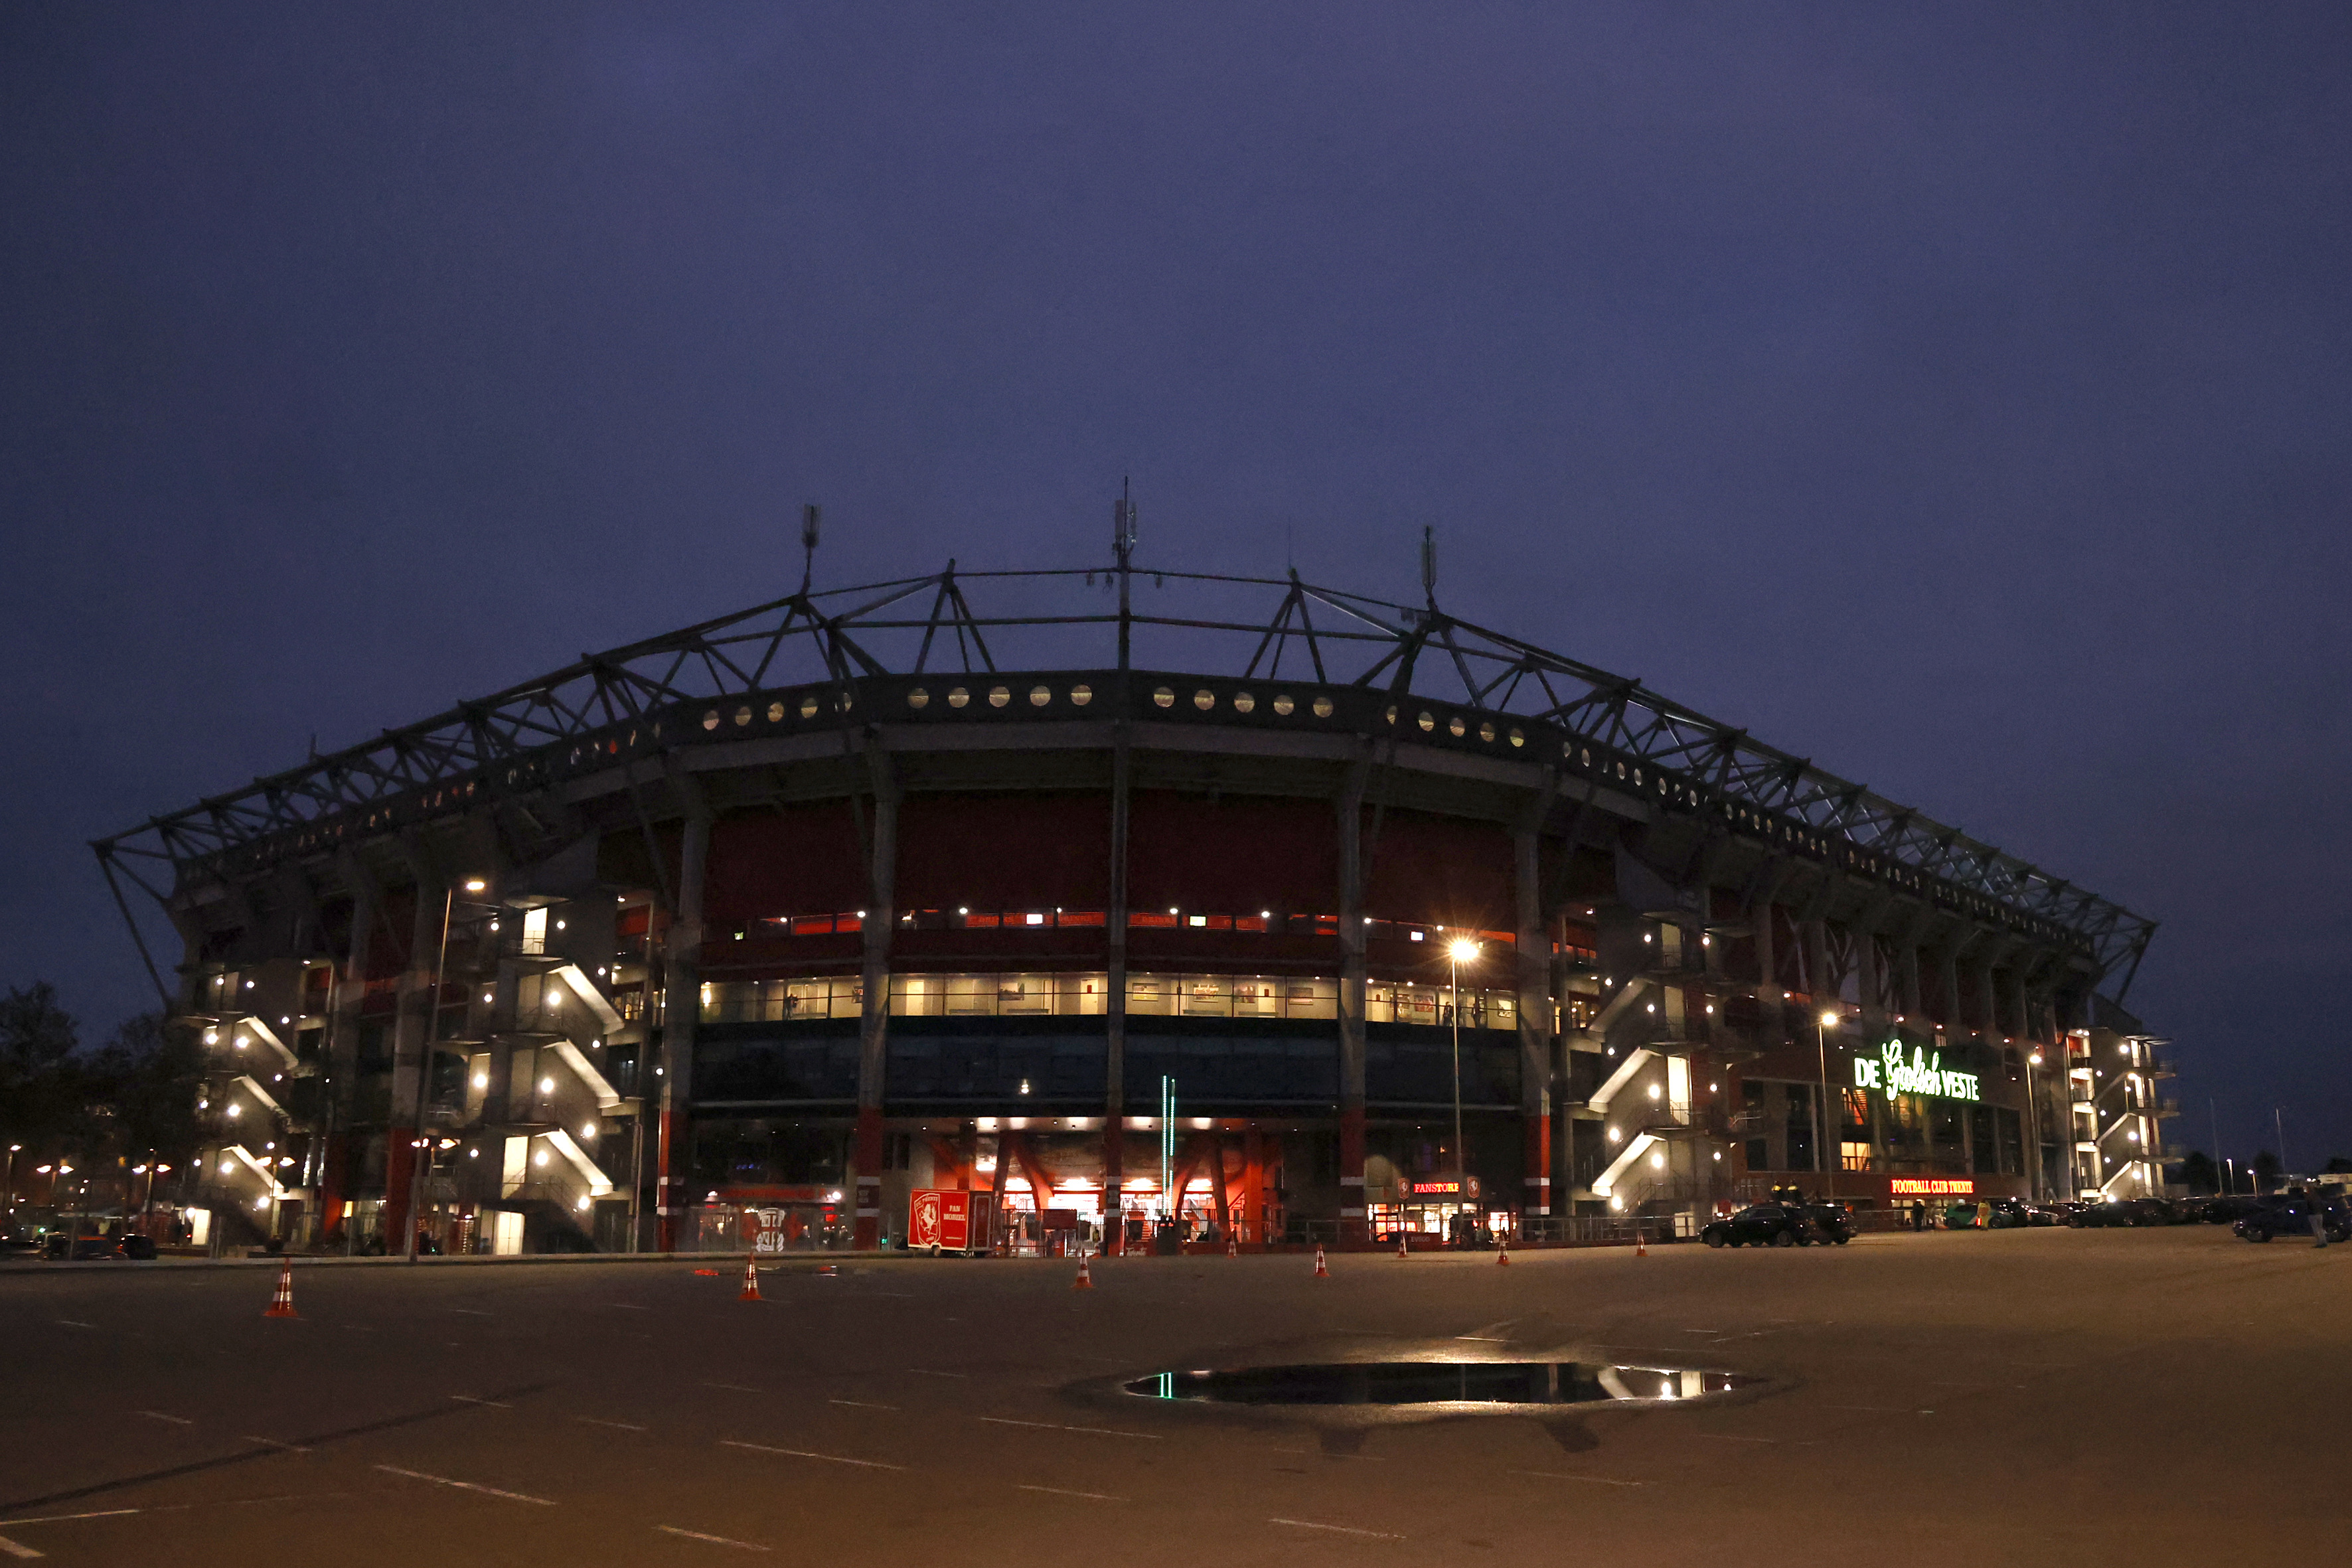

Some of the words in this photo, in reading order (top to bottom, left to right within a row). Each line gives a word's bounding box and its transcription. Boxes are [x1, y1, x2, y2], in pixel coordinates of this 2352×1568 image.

[1854, 1058, 1881, 1089] DE
[1882, 1039, 1941, 1101] Grolsch
[1940, 1070, 1980, 1101] VESTE
[1414, 1182, 1459, 1193] FANSTORE
[1891, 1180, 1931, 1193] FOOTBALL
[1931, 1180, 1948, 1194] CLUB
[1948, 1181, 1973, 1193] TWENTE
